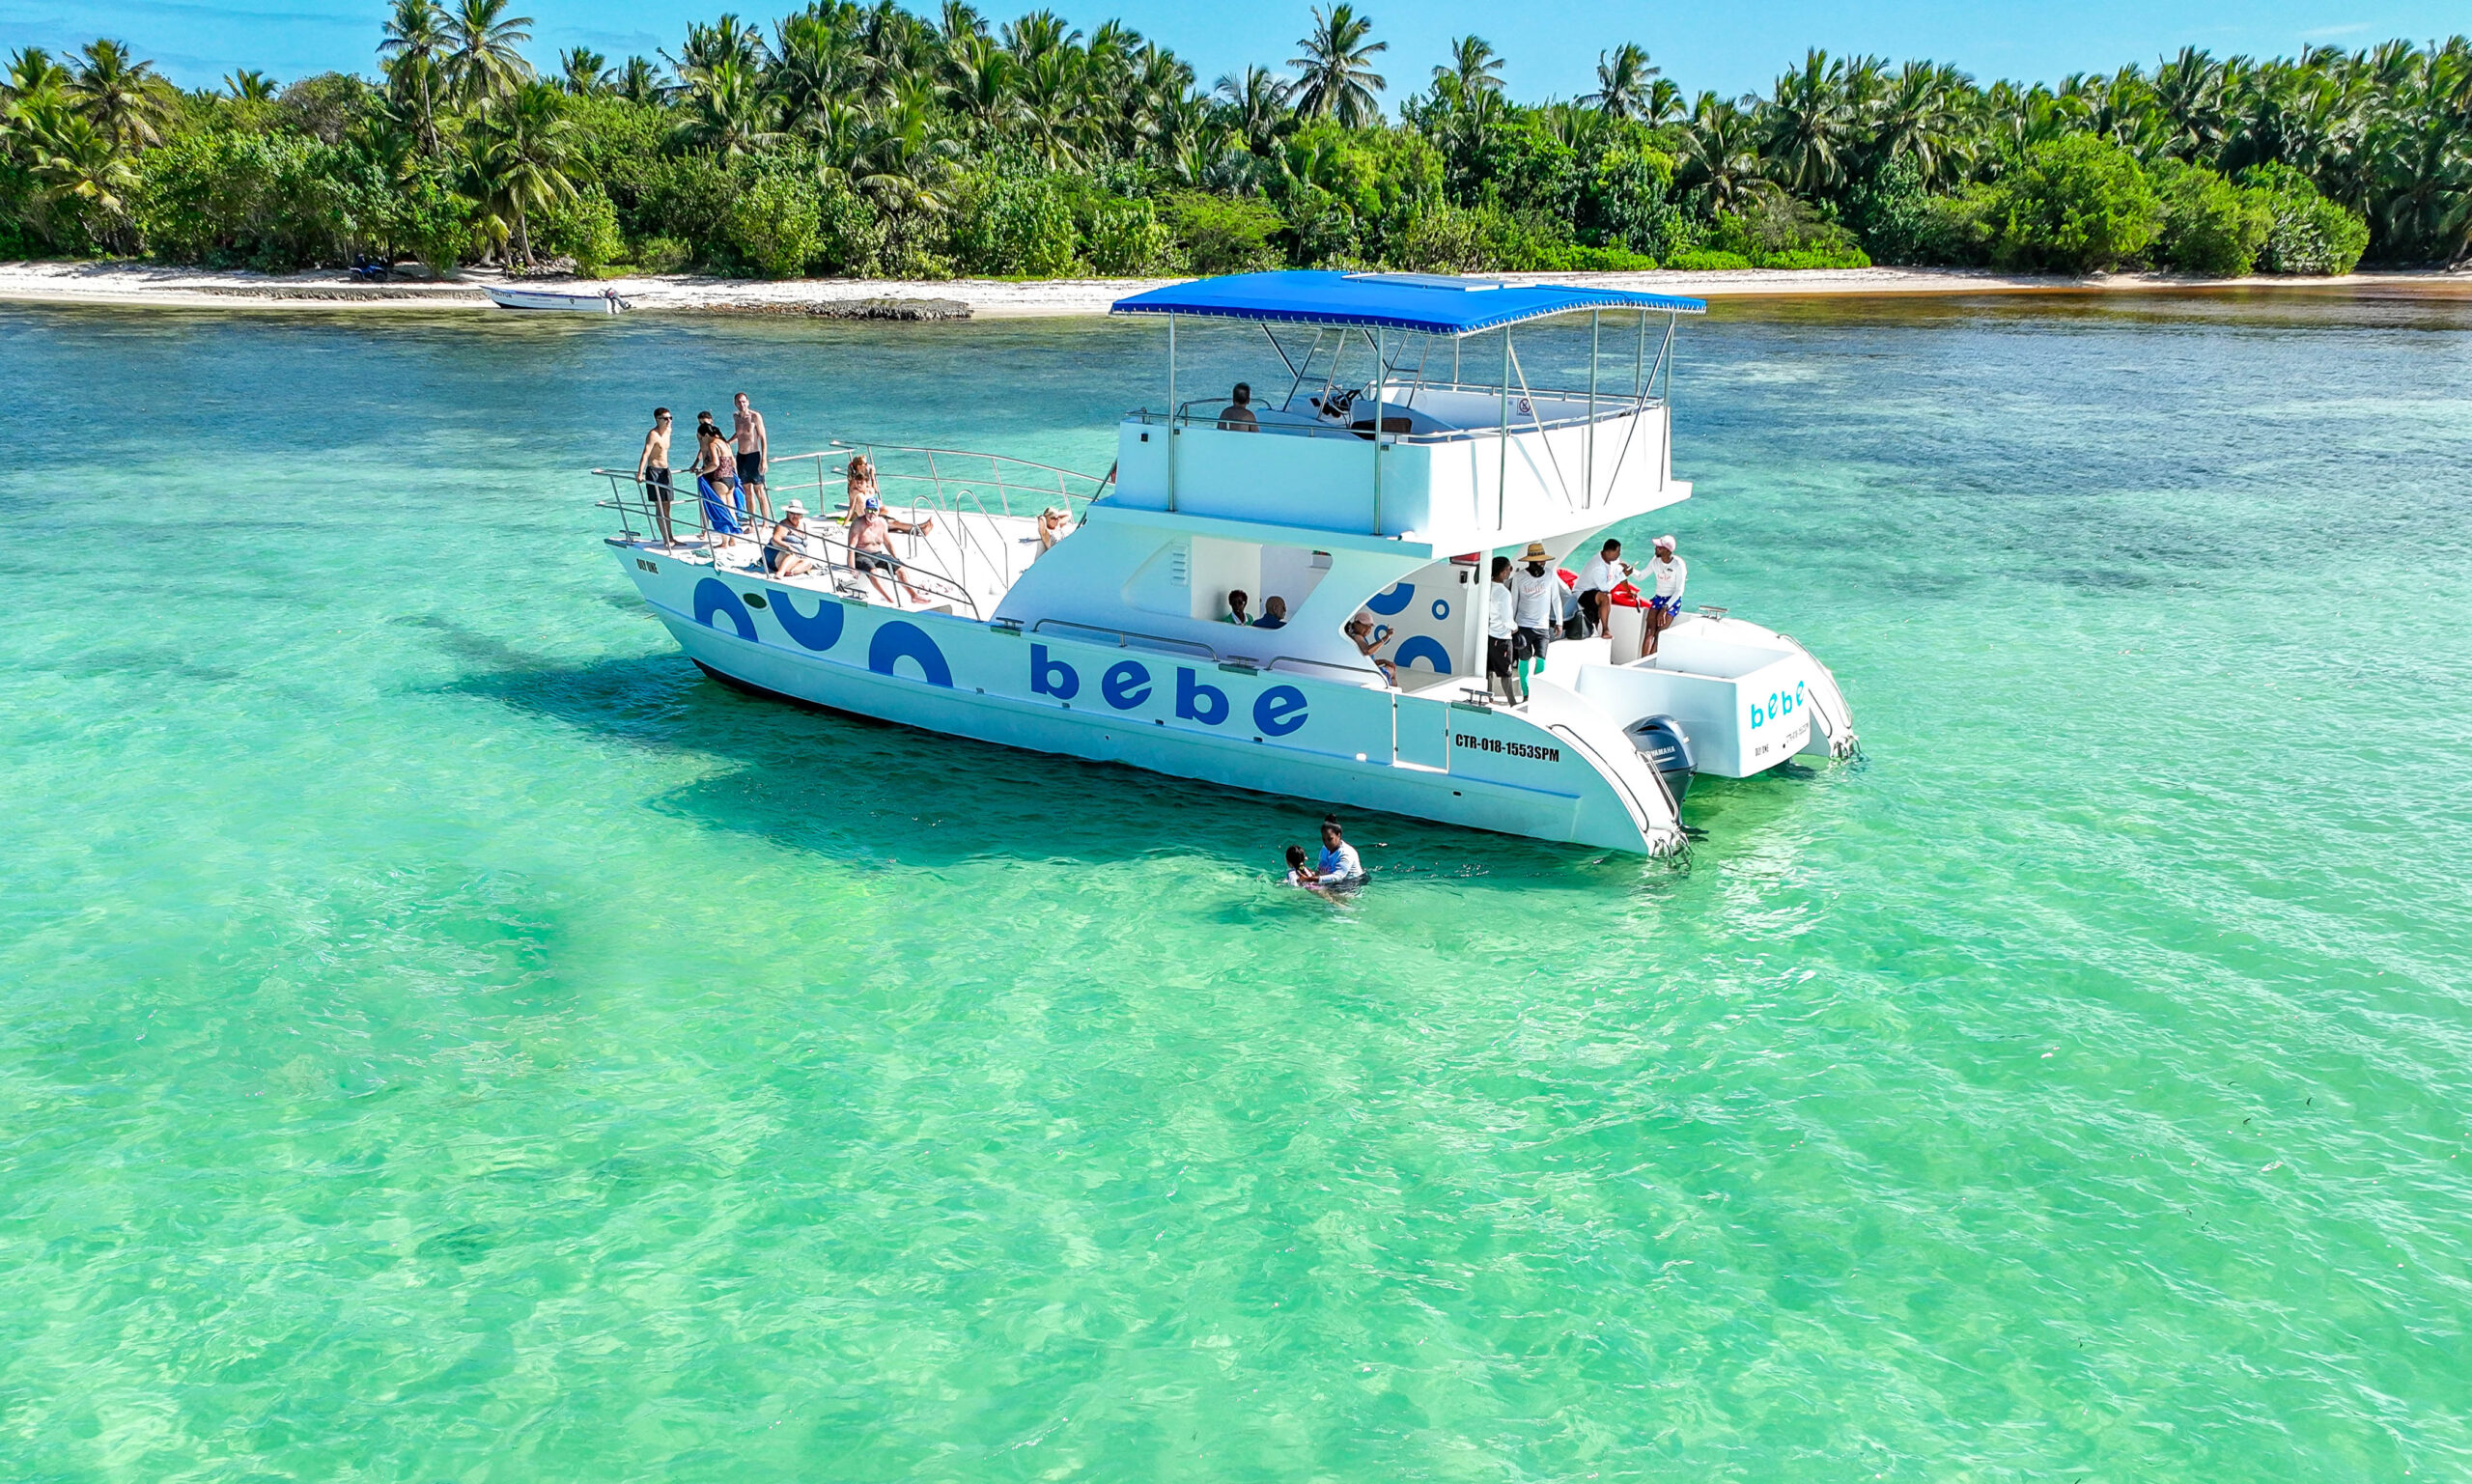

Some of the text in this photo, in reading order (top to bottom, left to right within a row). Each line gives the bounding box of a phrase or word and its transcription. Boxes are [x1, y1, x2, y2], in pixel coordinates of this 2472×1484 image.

[1030, 643, 1309, 737] bebe
[1751, 681, 1805, 730] bebe
[1455, 734, 1559, 763] CTR-018-1553SPM
[1650, 745, 1675, 757] YAMAHA
